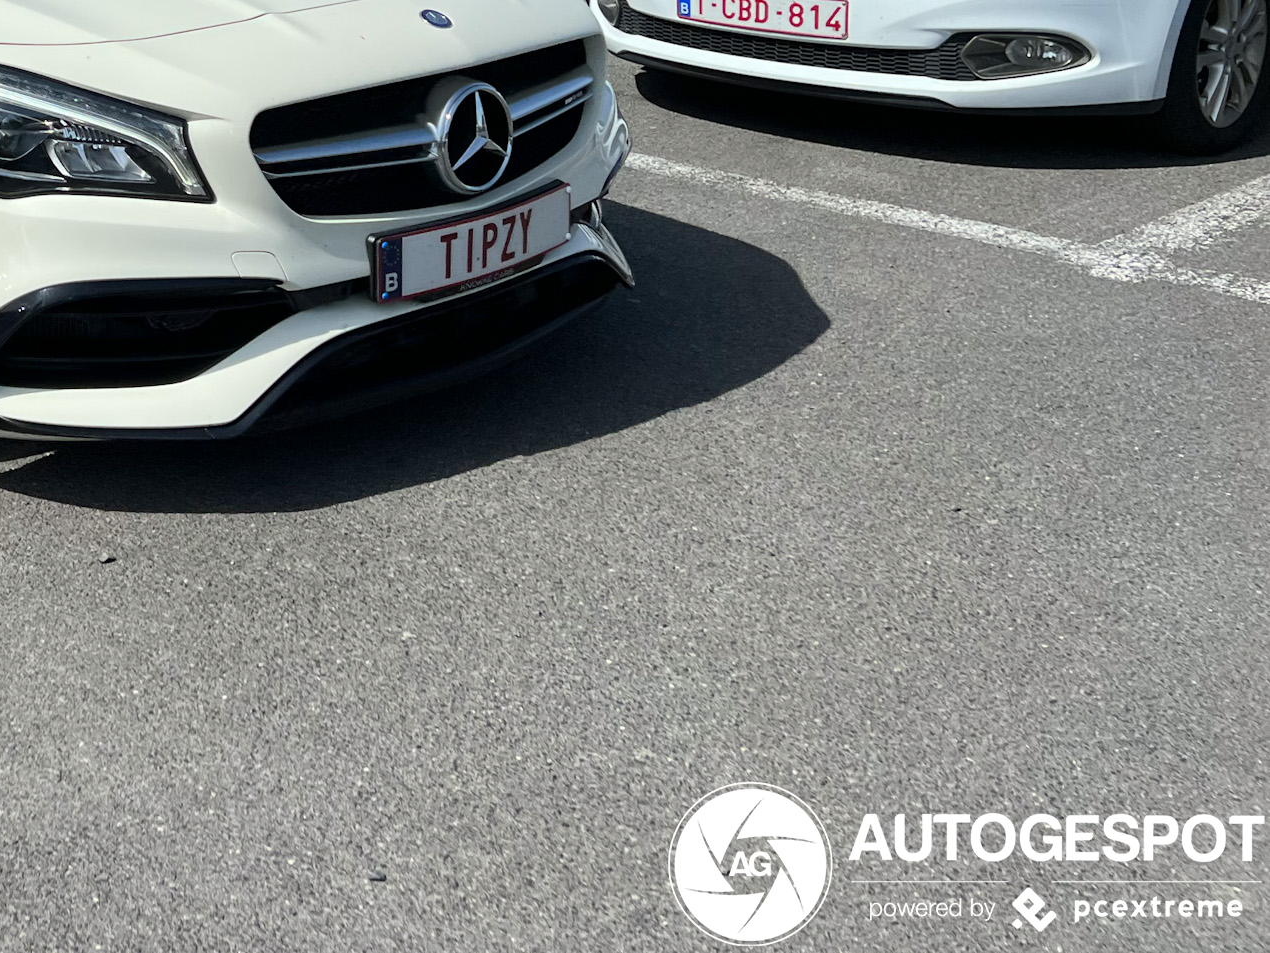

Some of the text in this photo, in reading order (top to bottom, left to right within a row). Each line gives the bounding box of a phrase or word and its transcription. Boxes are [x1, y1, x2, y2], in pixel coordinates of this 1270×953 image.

[681, 2, 689, 15] B
[440, 208, 533, 279] TIPZY
[385, 272, 398, 292] B
